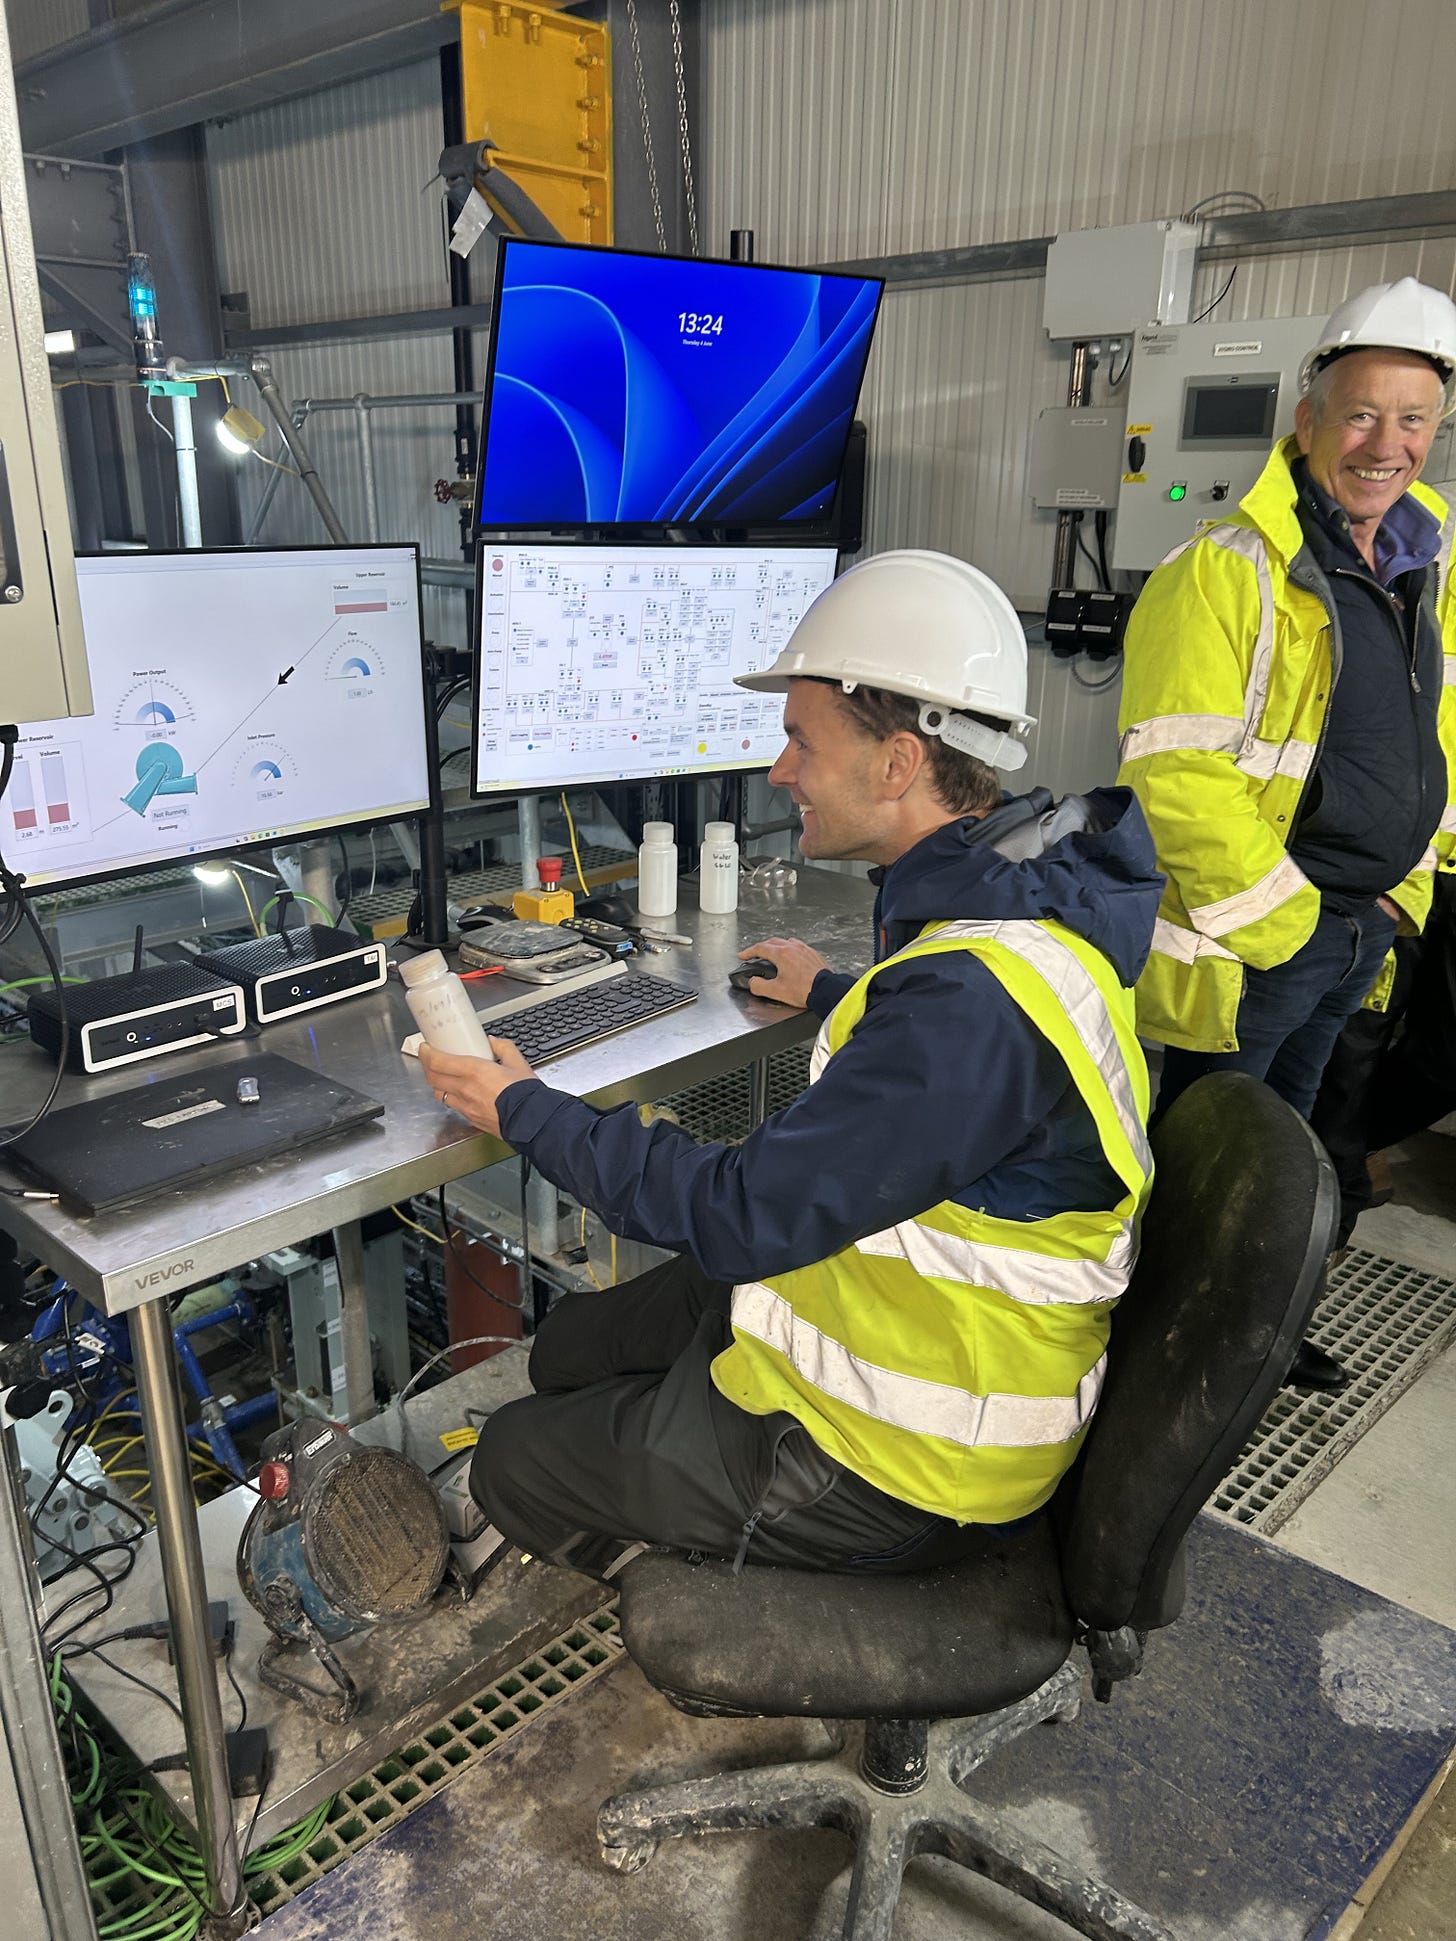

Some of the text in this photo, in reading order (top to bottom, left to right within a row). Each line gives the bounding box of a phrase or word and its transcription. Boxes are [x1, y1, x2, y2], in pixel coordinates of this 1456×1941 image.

[679, 312, 723, 335] 13:24
[149, 668, 167, 676] Output
[29, 734, 54, 742] Reservoir
[39, 749, 61, 757] Volume
[153, 808, 188, 819] Not Running
[158, 824, 178, 832] Running
[215, 998, 232, 1008] MCS
[135, 1258, 195, 1290] VEVOR
